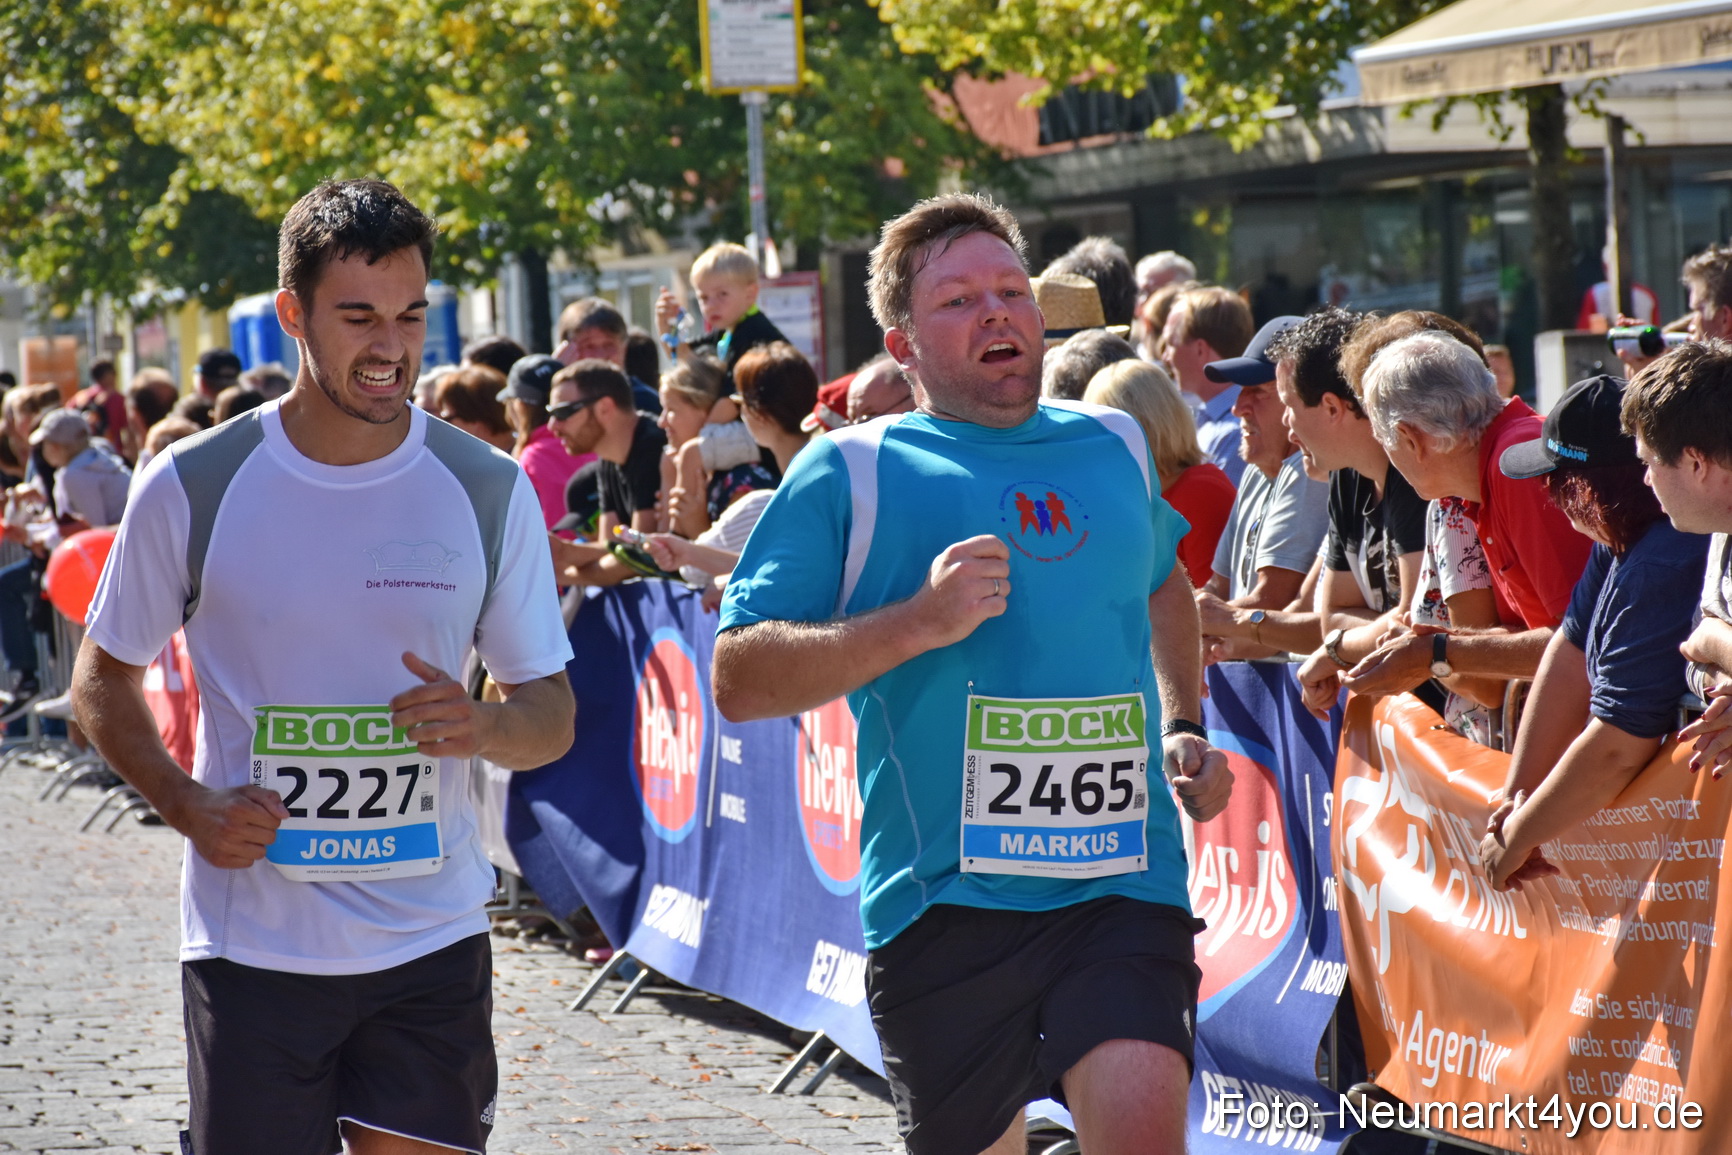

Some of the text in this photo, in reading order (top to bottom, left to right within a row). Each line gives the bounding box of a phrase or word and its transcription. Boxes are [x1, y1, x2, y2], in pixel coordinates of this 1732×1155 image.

[366, 579, 456, 592] Die Polsterwerkstatt
[982, 703, 1138, 746] BOCK
[276, 763, 420, 819] 2227
[988, 760, 1134, 816] 2465
[300, 836, 397, 860] JONAS
[1000, 831, 1119, 857] MARKUS
[1552, 837, 1635, 868] Konzeption
[1633, 832, 1659, 861] und
[1582, 872, 1639, 906] Projekte
[1596, 993, 1625, 1020] Sie
[1627, 992, 1661, 1022] sich
[1660, 994, 1677, 1025] bei
[1405, 1010, 1512, 1088] Agentur
[1568, 1030, 1681, 1070] web: codeclinic.de
[1567, 1069, 1598, 1096] tel:
